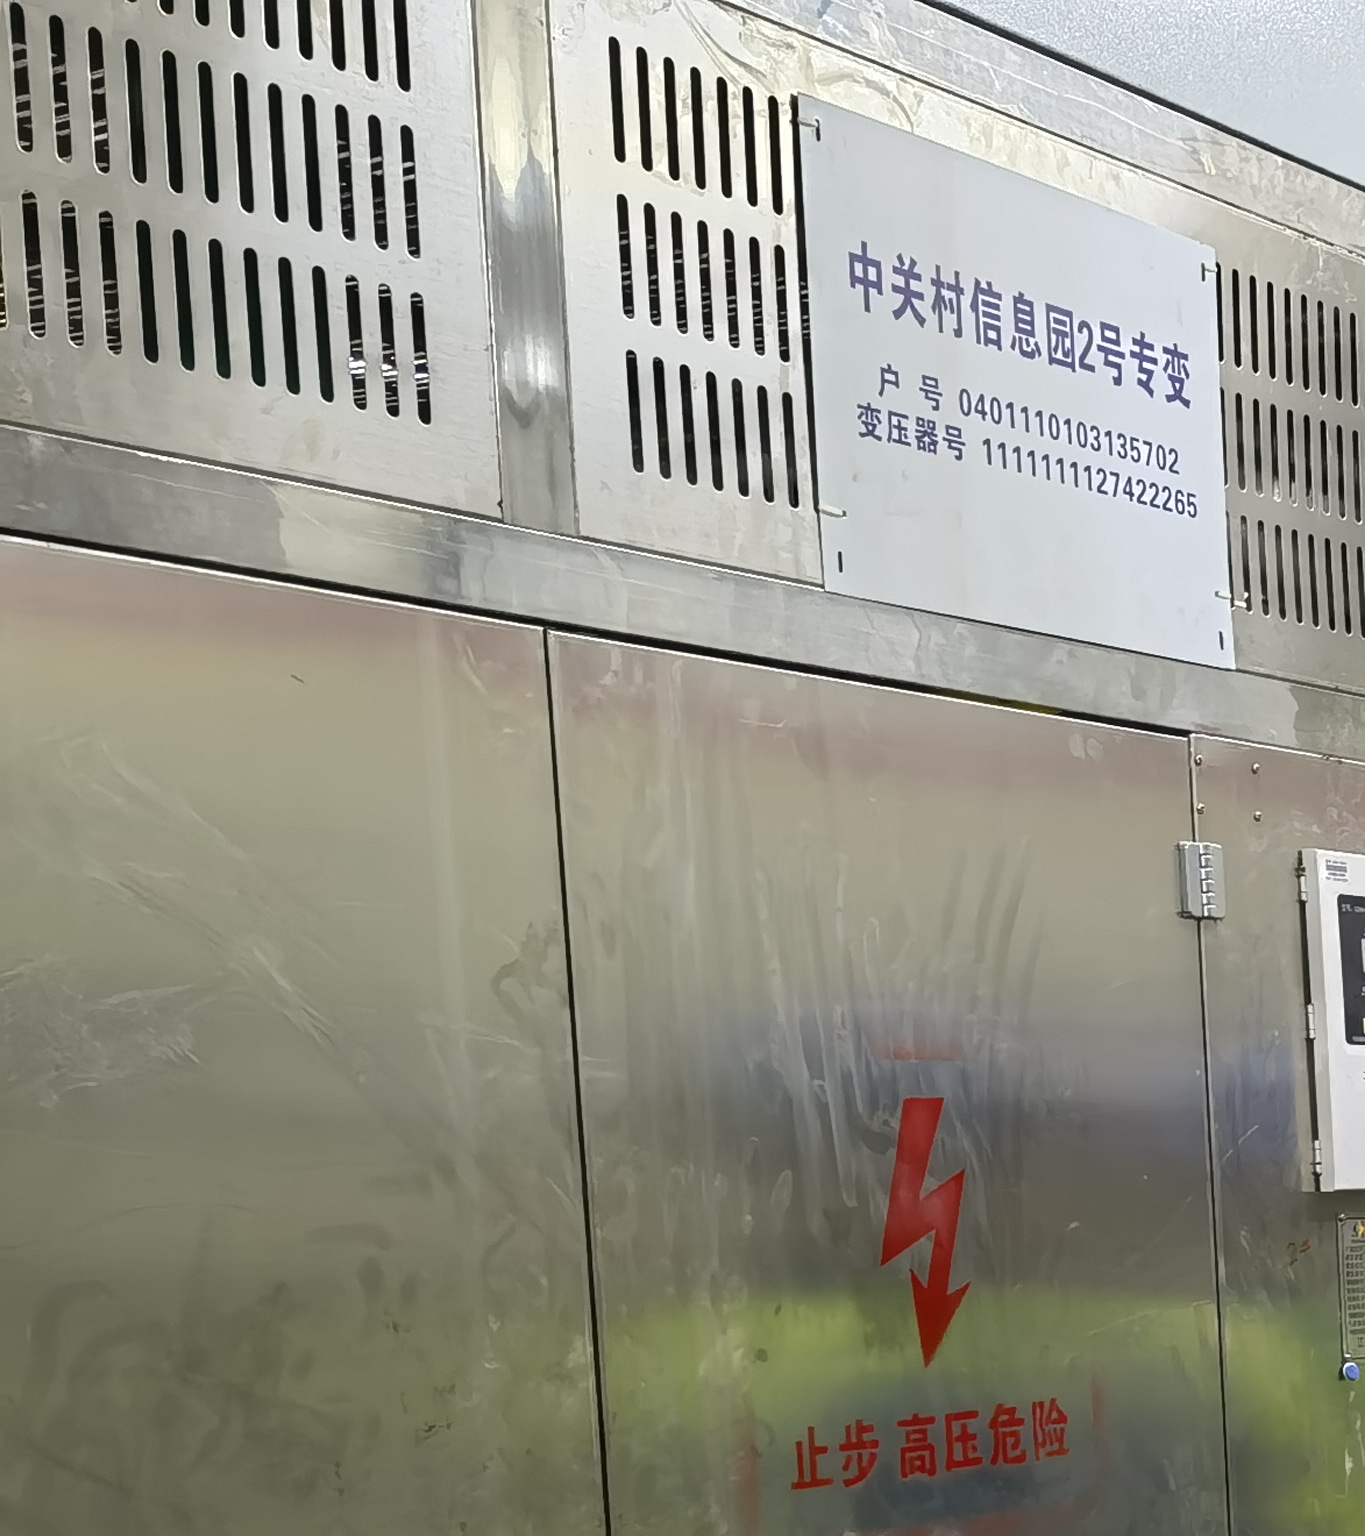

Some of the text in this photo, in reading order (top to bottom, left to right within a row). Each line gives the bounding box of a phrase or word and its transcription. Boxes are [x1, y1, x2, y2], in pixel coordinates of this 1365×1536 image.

[848, 240, 1192, 409] 中关村信息园2号专变
[856, 402, 1198, 519] 变压器号 1111111127422265
[959, 388, 1180, 475] 0401110103135702
[790, 1397, 1071, 1491] 止步 高压危险
